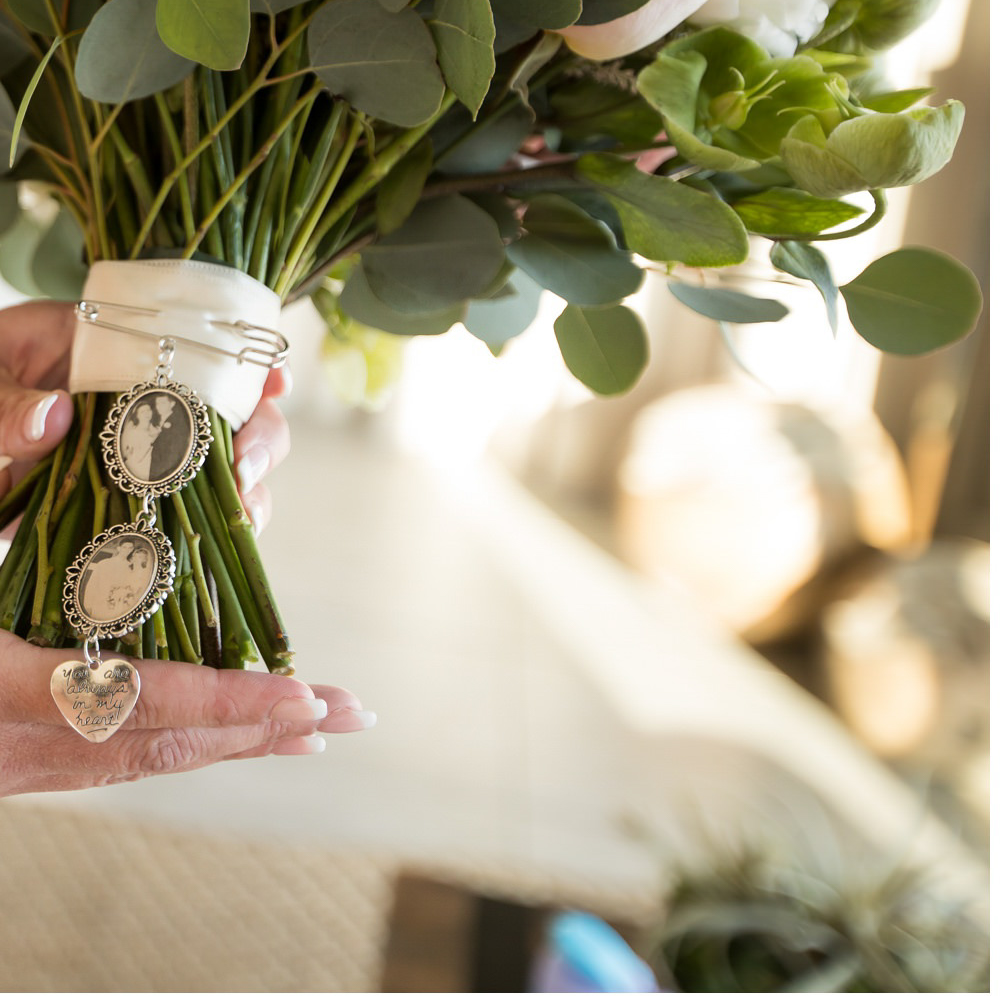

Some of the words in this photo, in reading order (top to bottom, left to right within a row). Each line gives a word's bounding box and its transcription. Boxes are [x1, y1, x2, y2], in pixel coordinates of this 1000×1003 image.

[103, 668, 131, 680] are
[66, 680, 128, 703] always
[72, 696, 91, 710] in
[96, 699, 124, 719] my
[75, 710, 119, 726] heart
